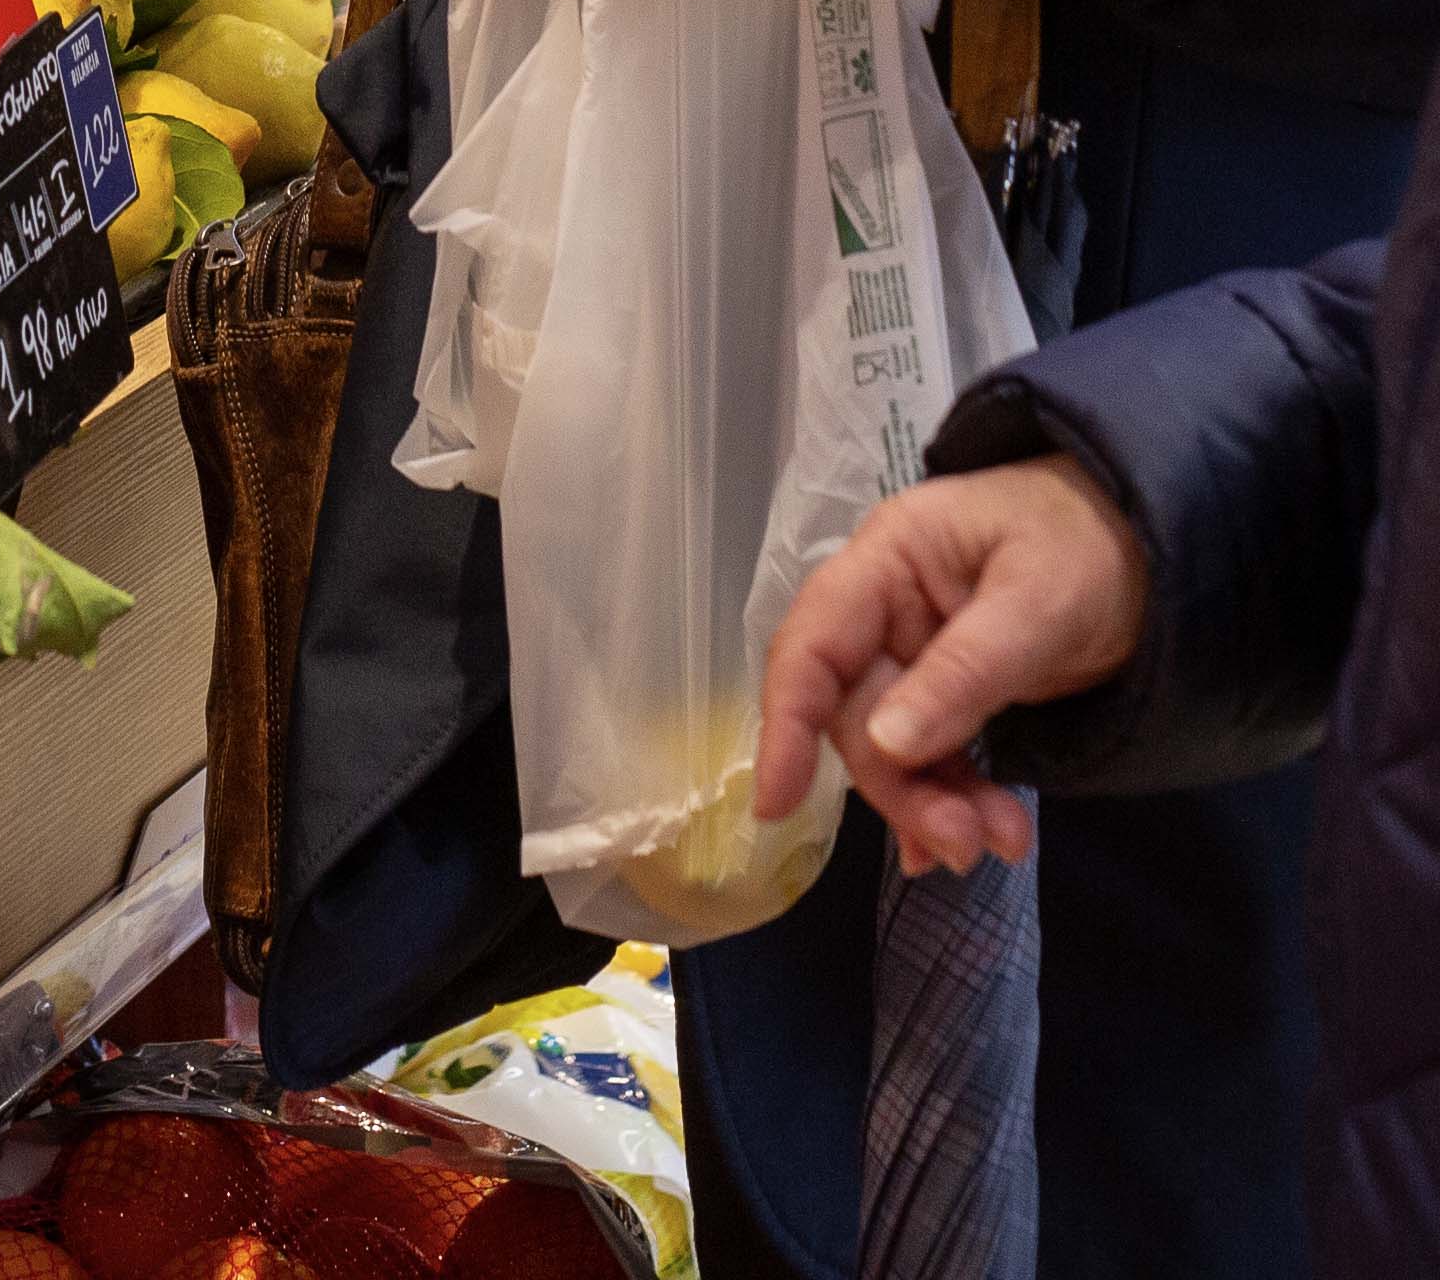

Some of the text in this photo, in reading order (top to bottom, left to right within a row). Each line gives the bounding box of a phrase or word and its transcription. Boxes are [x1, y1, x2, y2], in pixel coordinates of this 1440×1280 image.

[71, 34, 91, 60] TASTO
[71, 50, 100, 88] BILANCIA
[83, 104, 119, 189] 122
[0, 301, 54, 424] 1,98
[55, 313, 77, 361] AL
[75, 287, 108, 341] KILO
